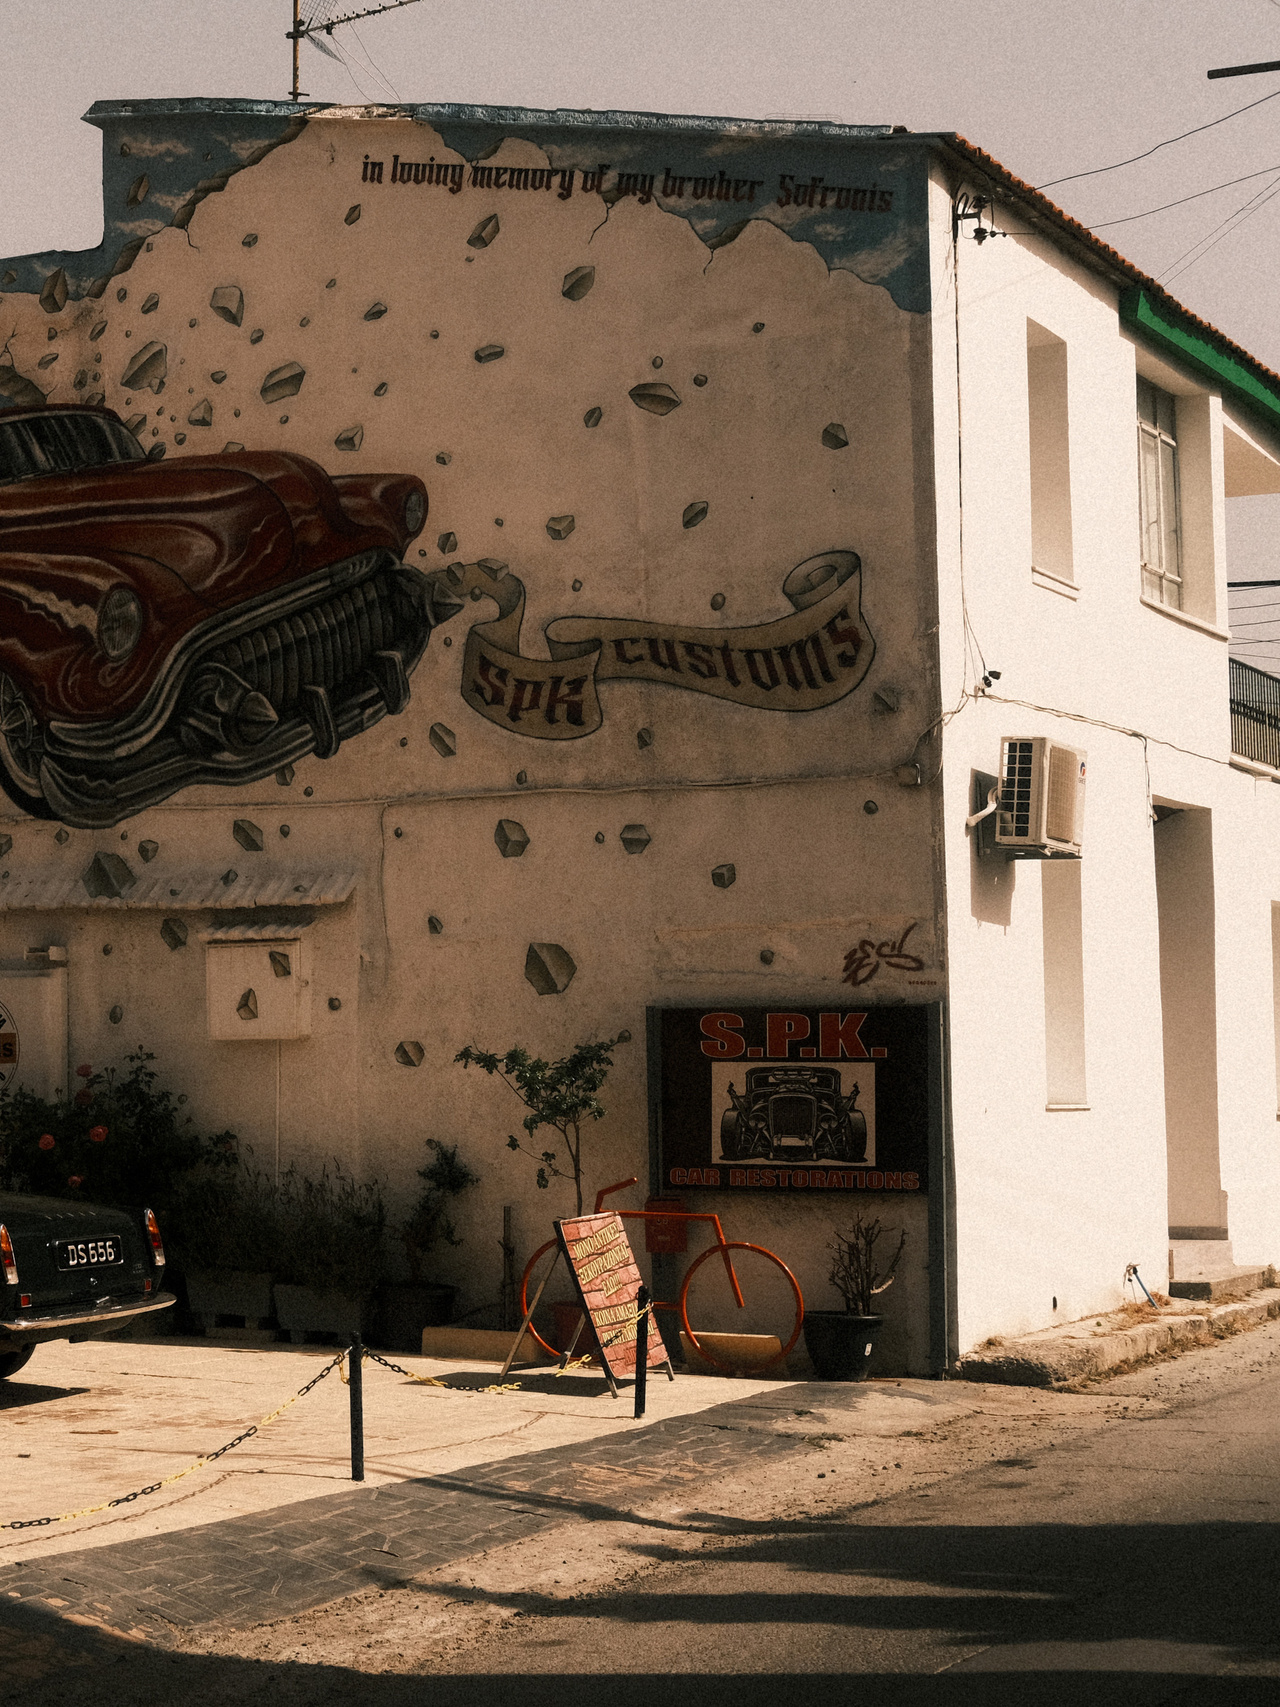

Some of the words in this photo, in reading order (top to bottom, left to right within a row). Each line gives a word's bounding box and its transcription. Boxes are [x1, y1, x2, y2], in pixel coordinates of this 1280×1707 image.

[361, 155, 384, 184] in
[390, 155, 464, 195] loving
[471, 162, 575, 200] memory
[581, 164, 611, 194] of
[617, 171, 656, 204] my
[661, 167, 764, 204] brother
[777, 173, 895, 214] Sofronis
[699, 1012, 888, 1058] S.P.K.
[670, 1168, 720, 1185] CAR
[730, 1168, 920, 1190] RESTORATIONS
[67, 1244, 88, 1266] DS
[88, 1241, 115, 1263] 656
